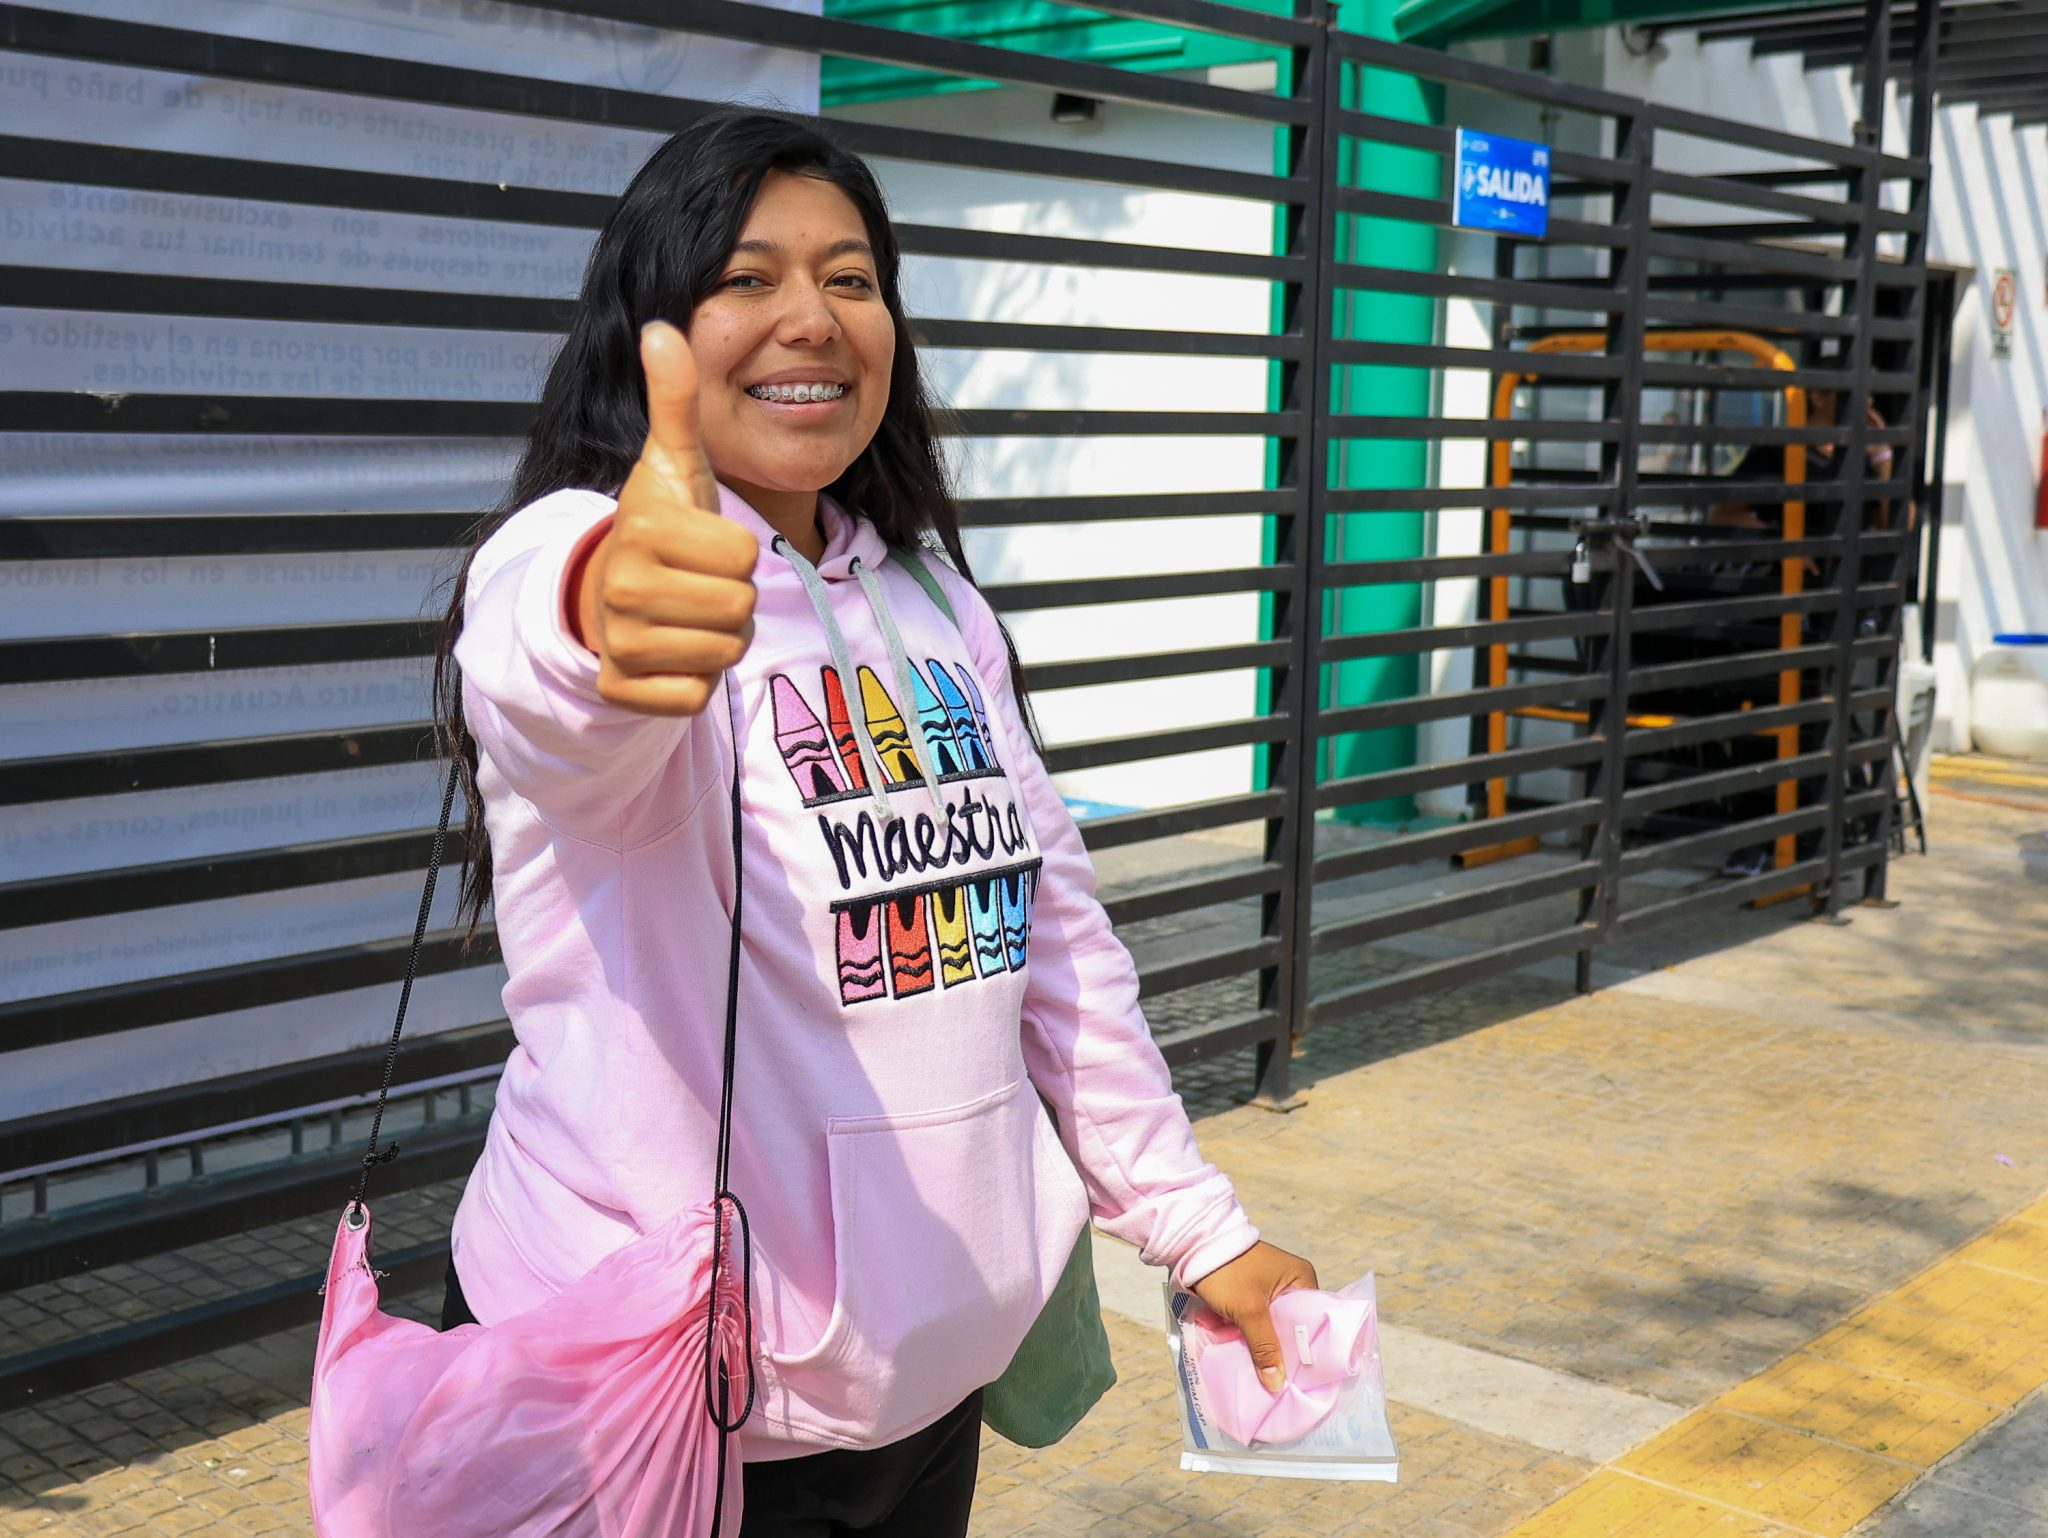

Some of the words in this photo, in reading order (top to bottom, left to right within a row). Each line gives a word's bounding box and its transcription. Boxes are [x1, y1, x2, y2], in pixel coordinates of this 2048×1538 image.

[1476, 165, 1546, 207] SALIDA
[1190, 1358, 1200, 1386] 100%
[1186, 1368, 1199, 1401] SWIM
[1194, 1401, 1207, 1427] CAP
